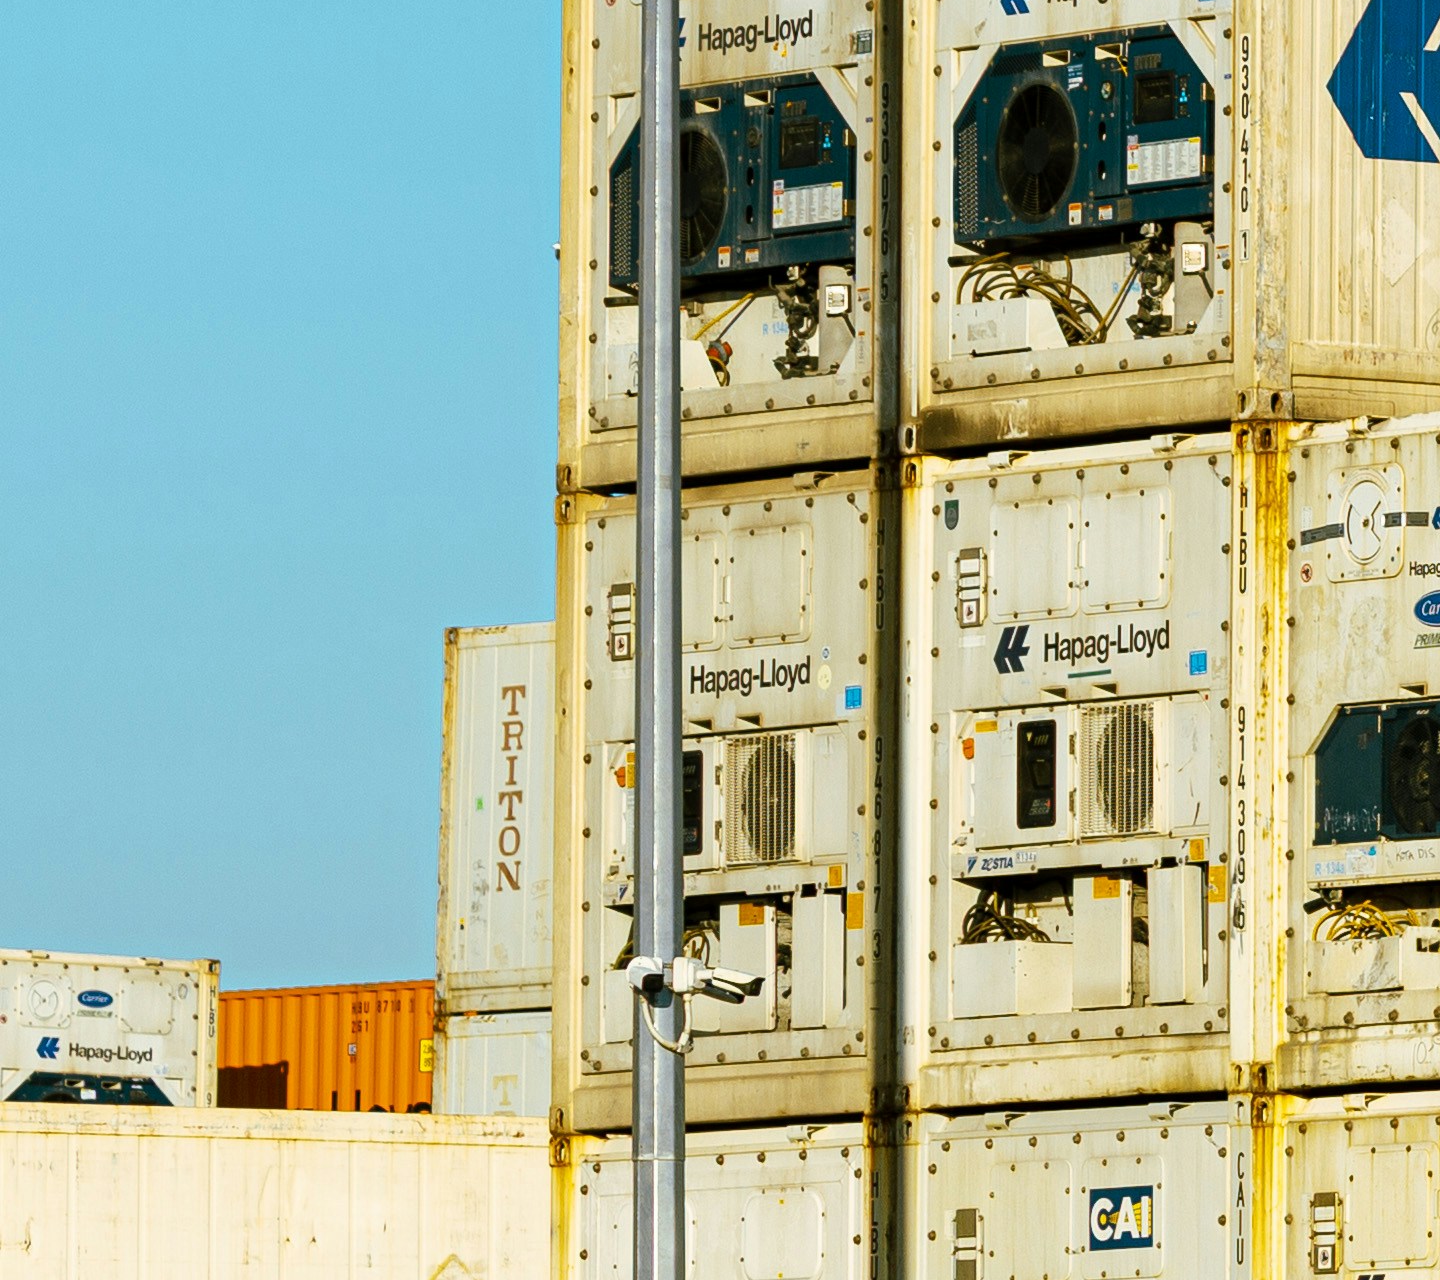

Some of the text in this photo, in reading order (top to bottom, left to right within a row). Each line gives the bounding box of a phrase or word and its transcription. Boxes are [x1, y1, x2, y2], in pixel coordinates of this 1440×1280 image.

[698, 9, 813, 53] Hapag-Lloyd
[1240, 35, 1250, 120] 930
[1240, 130, 1250, 215] 410
[1240, 234, 1249, 258] 1
[1044, 620, 1170, 666] Hapag-Lloyd
[690, 656, 811, 698] Hapag-Lloyd
[1236, 486, 1248, 883] HLBU 914 309
[496, 684, 527, 892] TRITON
[69, 1042, 153, 1064] Hapag-Lloyd
[1091, 1196, 1151, 1242] CAI
[1235, 1152, 1245, 1266] CAIU
